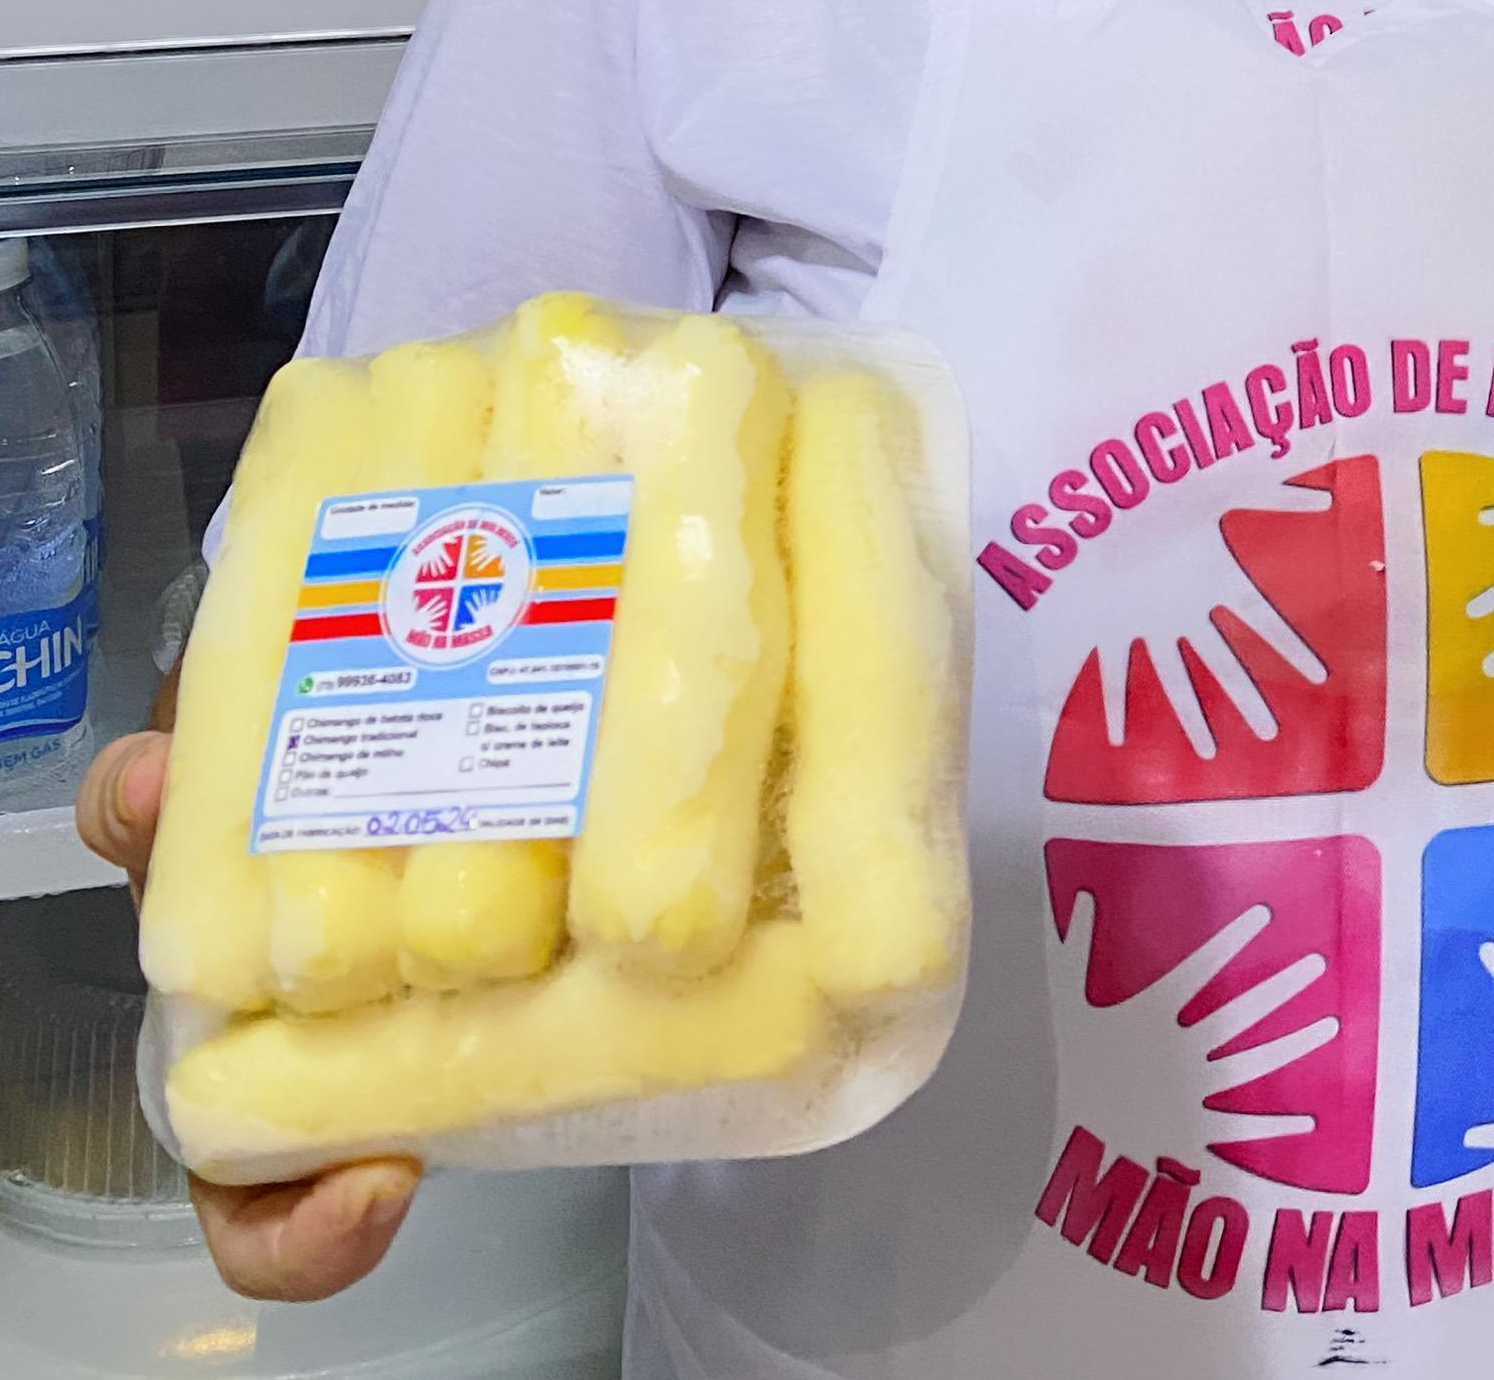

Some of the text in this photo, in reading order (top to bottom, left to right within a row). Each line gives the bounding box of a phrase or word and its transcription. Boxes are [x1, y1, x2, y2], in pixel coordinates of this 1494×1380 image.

[976, 338, 1372, 612] ASSOCIAÇÃO
[1391, 339, 1470, 414] DE
[1034, 1124, 1250, 1300] MÃO
[1260, 1207, 1381, 1313] NA
